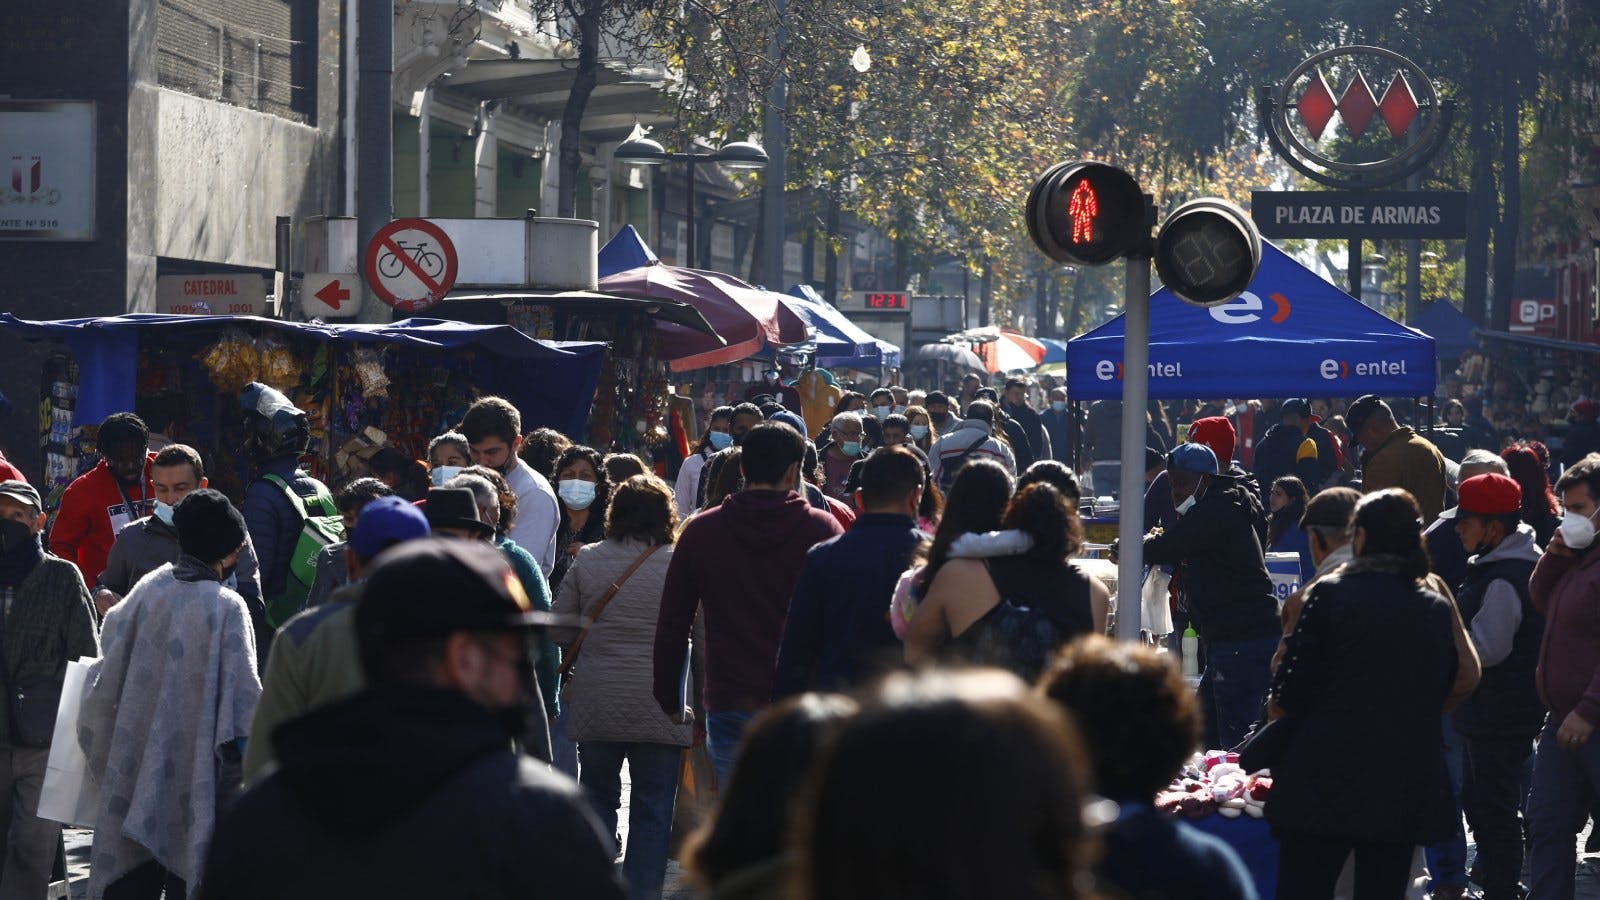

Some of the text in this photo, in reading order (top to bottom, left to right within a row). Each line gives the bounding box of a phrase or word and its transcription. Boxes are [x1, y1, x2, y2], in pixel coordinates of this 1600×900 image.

[1275, 206, 1441, 224] PLAZA DE ARMAS
[40, 219, 59, 228] 516
[184, 279, 237, 296] CATEDRAL
[228, 303, 253, 314] 1001
[1147, 362, 1183, 377] ntel
[1355, 359, 1407, 376] entel
